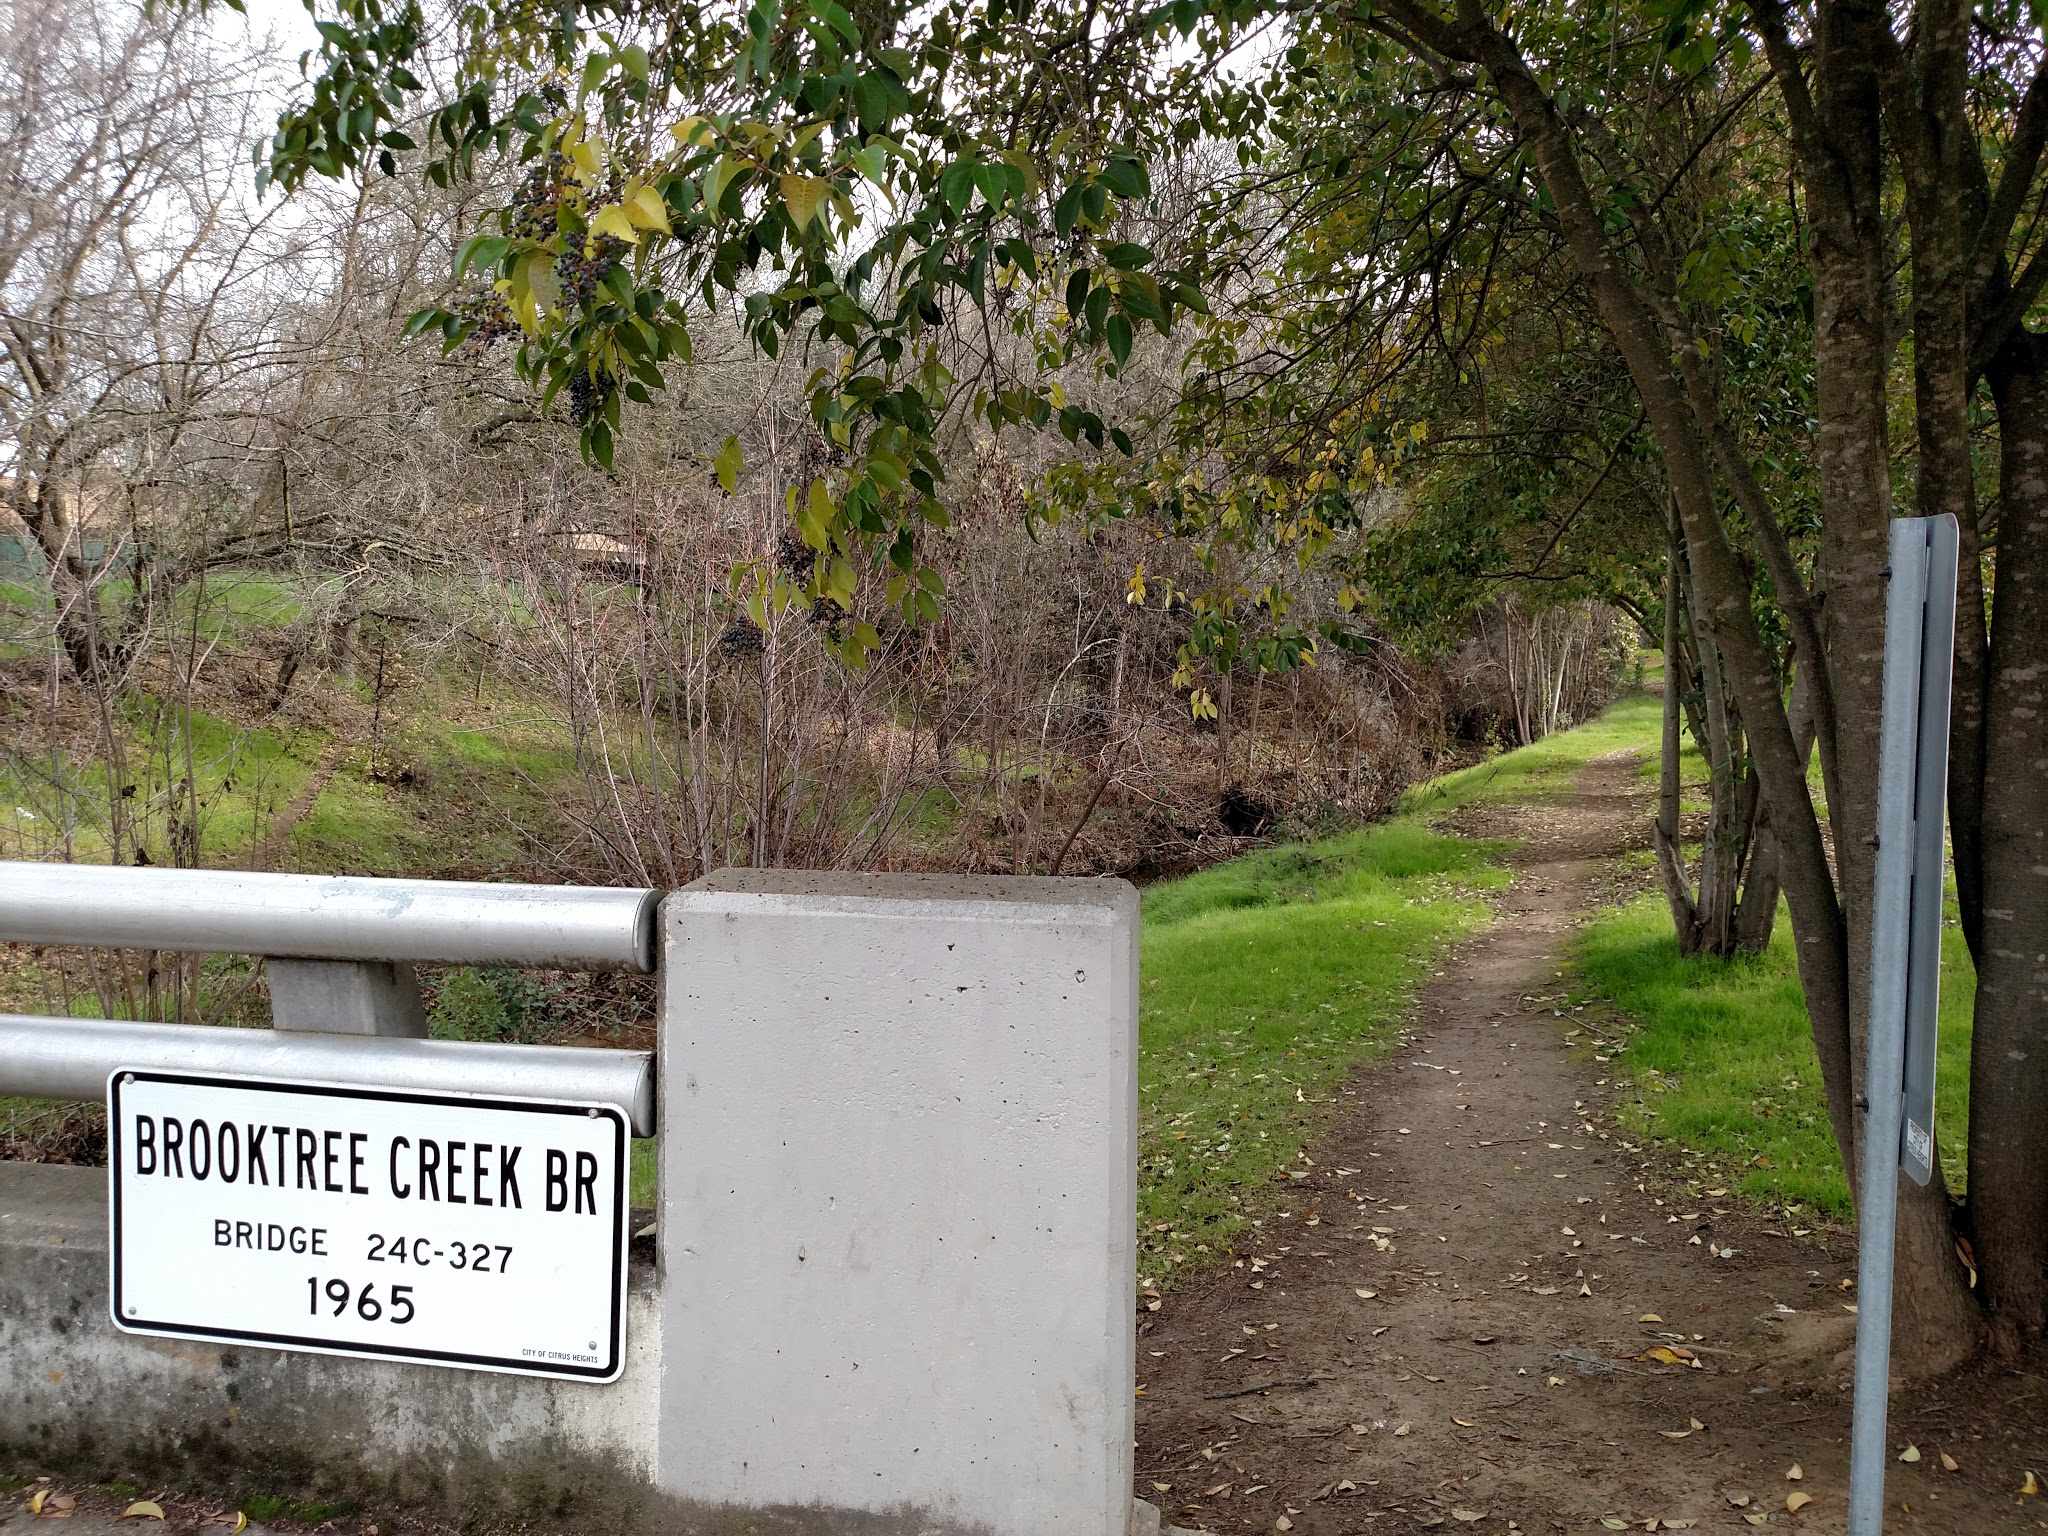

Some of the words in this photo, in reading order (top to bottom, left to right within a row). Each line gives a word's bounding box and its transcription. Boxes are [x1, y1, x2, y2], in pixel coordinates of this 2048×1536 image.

[135, 1114, 369, 1195] BROOKTREE
[389, 1135, 523, 1210] CREEK
[545, 1148, 598, 1216] BR
[214, 1218, 328, 1257] BRIDGE
[367, 1233, 513, 1274] 24C-327
[307, 1276, 416, 1325] 1965
[522, 1348, 536, 1357] CITY
[538, 1350, 546, 1358] OF
[548, 1351, 571, 1361] CITRUS
[572, 1354, 598, 1364] HEIGHTS
